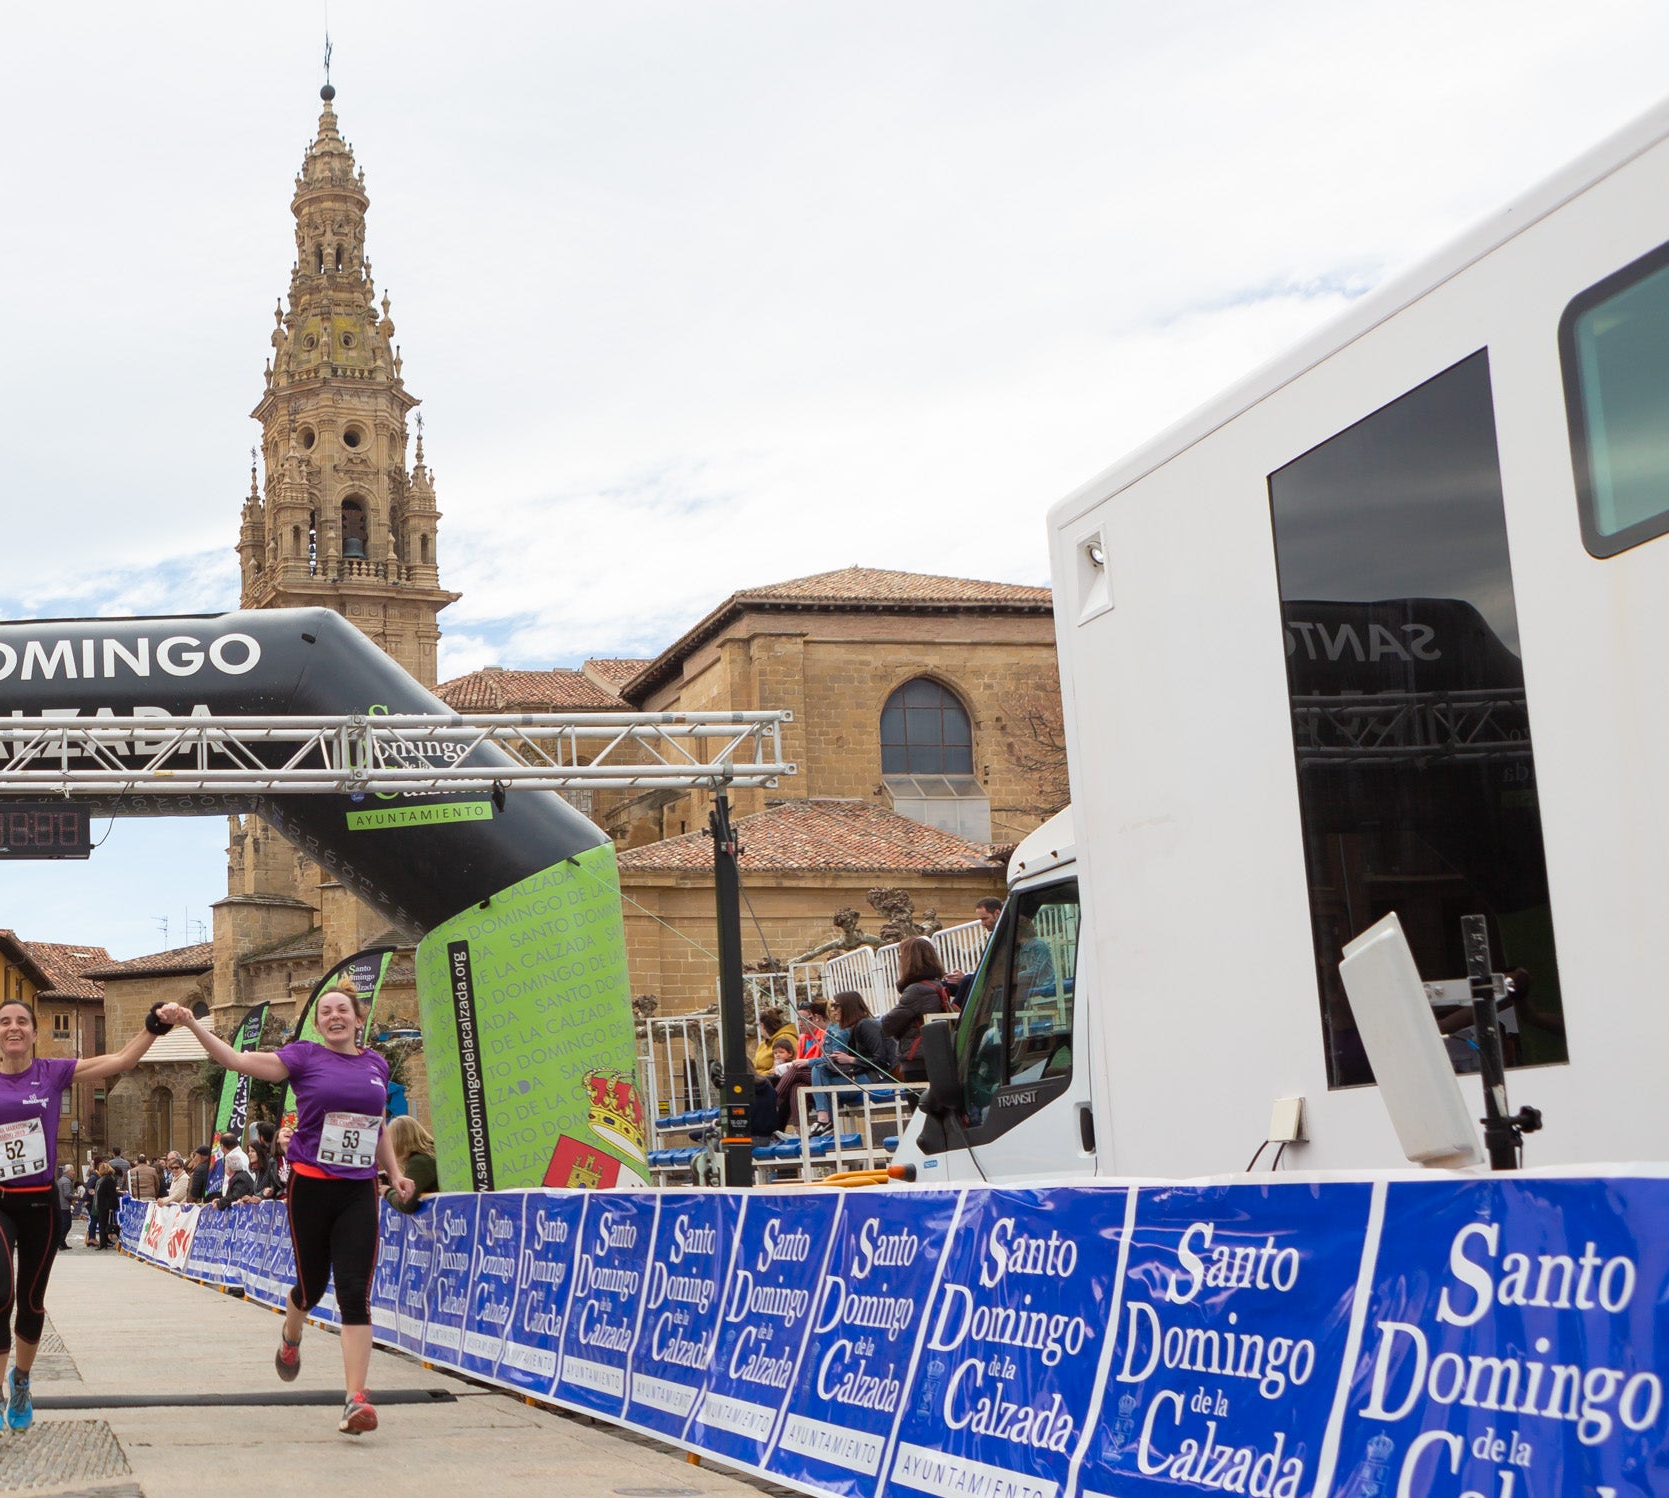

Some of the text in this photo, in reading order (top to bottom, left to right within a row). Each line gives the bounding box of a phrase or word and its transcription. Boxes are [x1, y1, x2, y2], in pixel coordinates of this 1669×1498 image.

[356, 806, 484, 826] AYUNTAMIENTO
[468, 895, 563, 941] DOMINGO
[510, 918, 569, 949] SANTO
[348, 964, 372, 975] Santo
[494, 962, 516, 980] LA
[520, 936, 596, 969] CALZADA
[492, 961, 585, 1005] DOMINGO
[535, 984, 592, 1014] SANTO
[491, 1003, 614, 1055] DE LA CALZADA
[516, 1029, 607, 1069] DOMINGO
[559, 1051, 612, 1081] SANTO
[516, 1092, 569, 1122] DE LA
[997, 1090, 1038, 1108] TRANSIT
[4, 1139, 26, 1160] 52
[342, 1130, 360, 1149] 53
[442, 1209, 467, 1244] Santo
[486, 1209, 513, 1247] Santo
[534, 1210, 568, 1250] Santo
[595, 1212, 637, 1257] Santo
[670, 1214, 716, 1264] Santo
[756, 1218, 810, 1273] Santo
[850, 1217, 918, 1279] Santo
[979, 1217, 1078, 1288] Santo
[1165, 1222, 1300, 1304] Santo
[1435, 1222, 1636, 1327] Santo
[575, 1254, 639, 1302] Domingo
[726, 1269, 809, 1328] Domingo
[579, 1299, 632, 1352] Calzada
[814, 1275, 914, 1342] Domingo
[927, 1283, 1085, 1366] Domingo
[728, 1325, 793, 1389] Calzada
[854, 1335, 876, 1358] de la
[988, 1353, 1017, 1380] de la
[1116, 1301, 1315, 1400] Domingo
[817, 1338, 900, 1413] Calzada
[1358, 1321, 1662, 1446] Domingo
[943, 1358, 1074, 1453] Calzada
[1190, 1386, 1229, 1418] de la
[789, 1424, 877, 1464] AYUNTAMIENTO
[1137, 1389, 1304, 1498] Calzada
[1472, 1427, 1506, 1461] de
[1508, 1430, 1533, 1467] la
